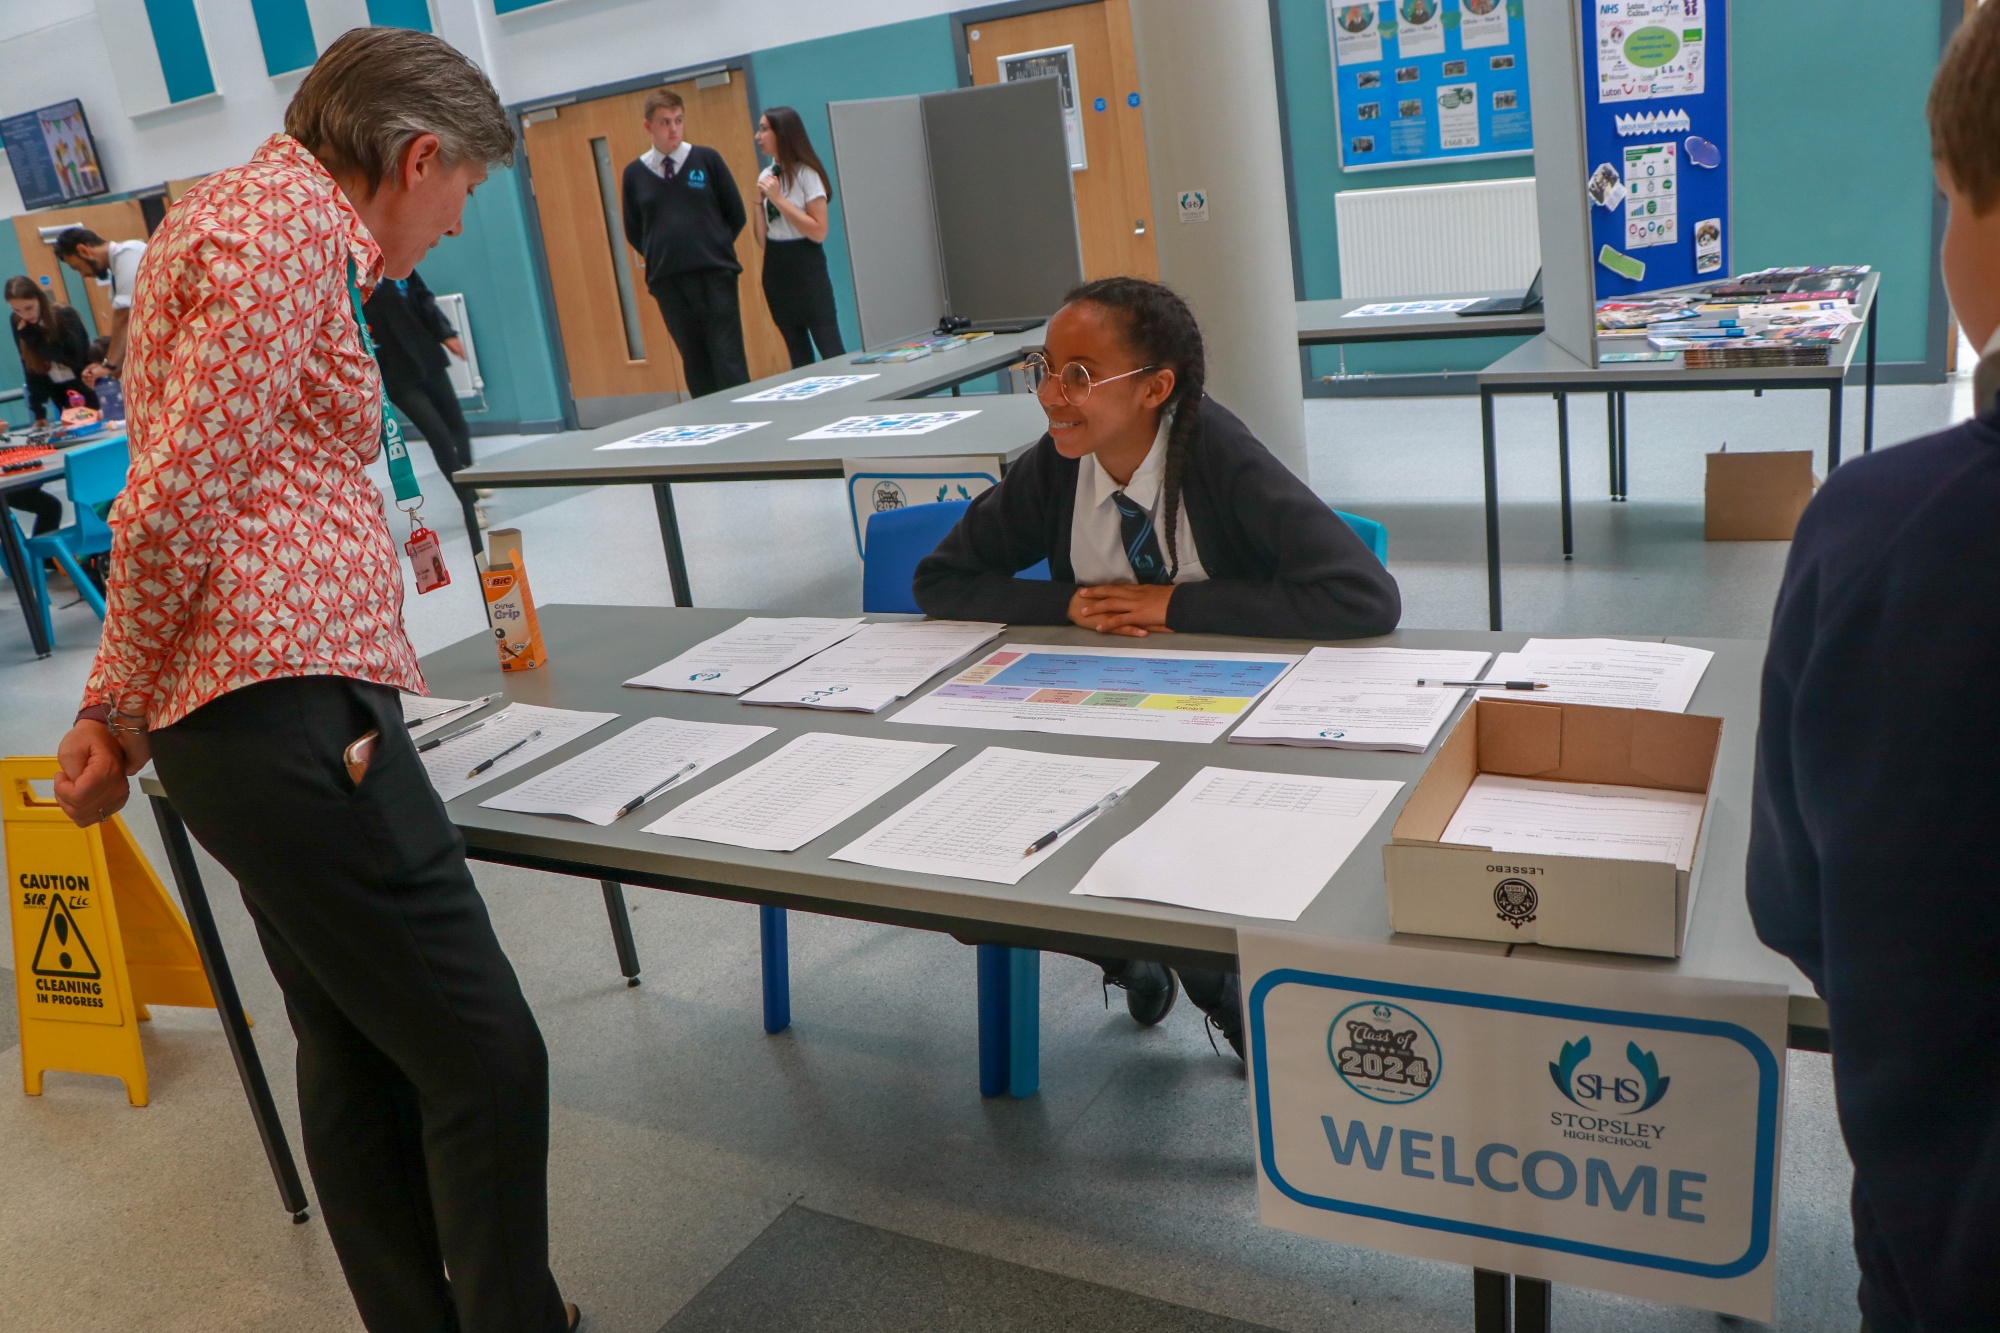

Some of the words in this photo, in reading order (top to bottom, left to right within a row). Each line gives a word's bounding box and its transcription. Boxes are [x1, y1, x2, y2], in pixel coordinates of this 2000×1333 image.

[1600, 4, 1619, 15] NHS
[1602, 88, 1621, 96] Luton
[385, 417, 406, 461] BIG
[492, 577, 510, 586] BIC
[494, 609, 520, 620] Grip
[1486, 864, 1544, 876] LESSEBO
[20, 874, 90, 892] CAUTION
[24, 893, 46, 906] SIR
[36, 978, 102, 995] CLEANING
[37, 994, 48, 1004] IN
[52, 994, 104, 1008] PROGRESS
[1349, 1023, 1391, 1044] Class
[1397, 1033, 1414, 1050] of
[1341, 1050, 1428, 1084] 2024
[1576, 1074, 1640, 1104] SHS
[1550, 1111, 1666, 1140] STOPSLEY
[1563, 1129, 1595, 1142] HIGH
[1598, 1134, 1652, 1149] SCHOOL
[1320, 1114, 1707, 1224] WELCOME
